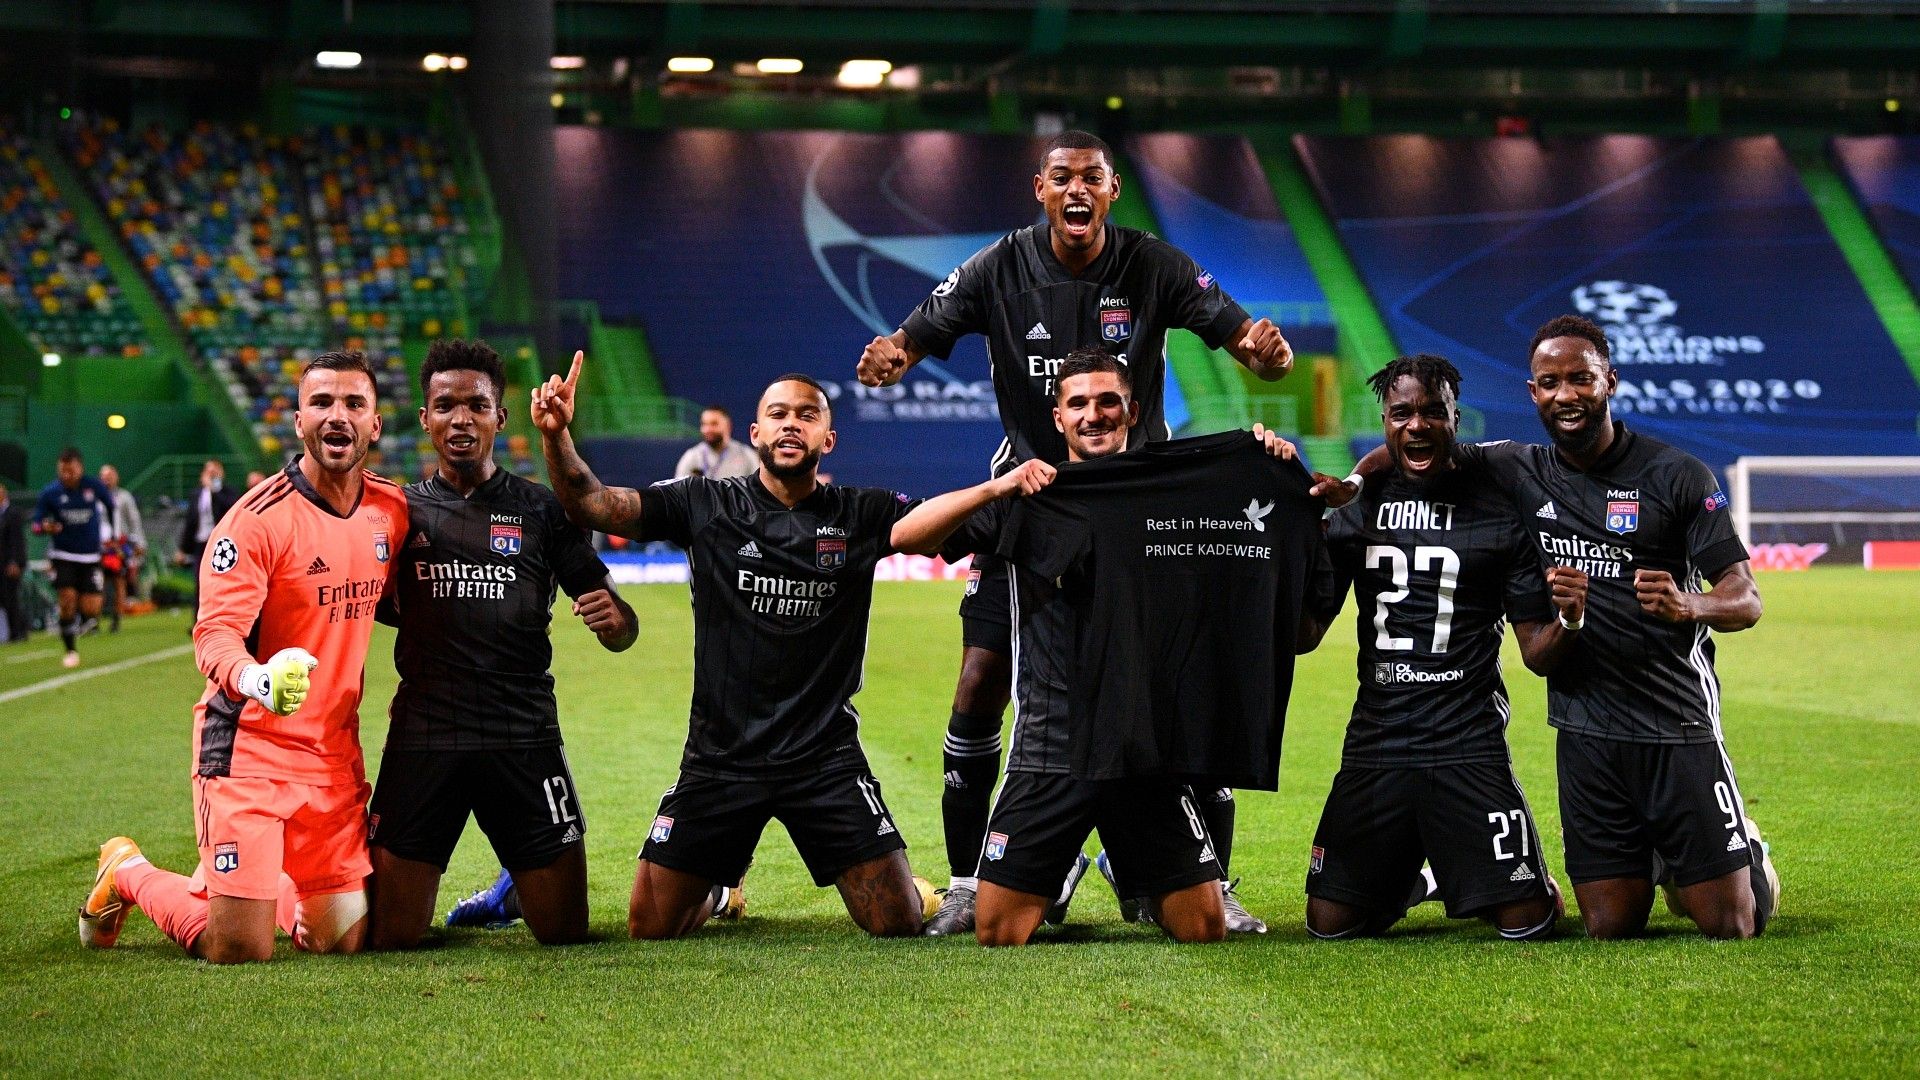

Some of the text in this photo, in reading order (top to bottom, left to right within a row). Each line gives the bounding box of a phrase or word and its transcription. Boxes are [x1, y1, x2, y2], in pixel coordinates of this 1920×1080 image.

[1099, 296, 1129, 308] Merci
[1706, 379, 1821, 399] 2020
[1609, 399, 1783, 414] ORTUGAL
[1606, 488, 1639, 500] Merci
[490, 513, 522, 525] Merci
[1146, 517, 1252, 531] Rest in Heaven
[1376, 501, 1457, 531] CORNET
[1536, 511, 1558, 520] adidas
[816, 525, 846, 536] Merci
[737, 549, 763, 559] adidas
[1145, 543, 1272, 560] PRINCE KADEWERE
[1539, 531, 1633, 562] Emirates
[306, 567, 330, 576] adidas
[415, 559, 517, 582] Emirates
[1576, 559, 1621, 578] BETTER
[318, 577, 386, 607] Emirates
[432, 580, 505, 600] FLY BETTER
[738, 569, 837, 598] Emirates
[751, 596, 821, 617] FLY BETTER
[1365, 545, 1461, 653] 27
[1395, 663, 1412, 673] OL
[1396, 670, 1464, 683] FONDATION
[543, 776, 577, 825] 12
[1714, 781, 1738, 829] 9
[1181, 796, 1204, 839] 8
[1488, 809, 1529, 860] 27
[1727, 841, 1747, 851] adidas
[1199, 854, 1215, 863] adidas
[1509, 872, 1536, 881] adidas
